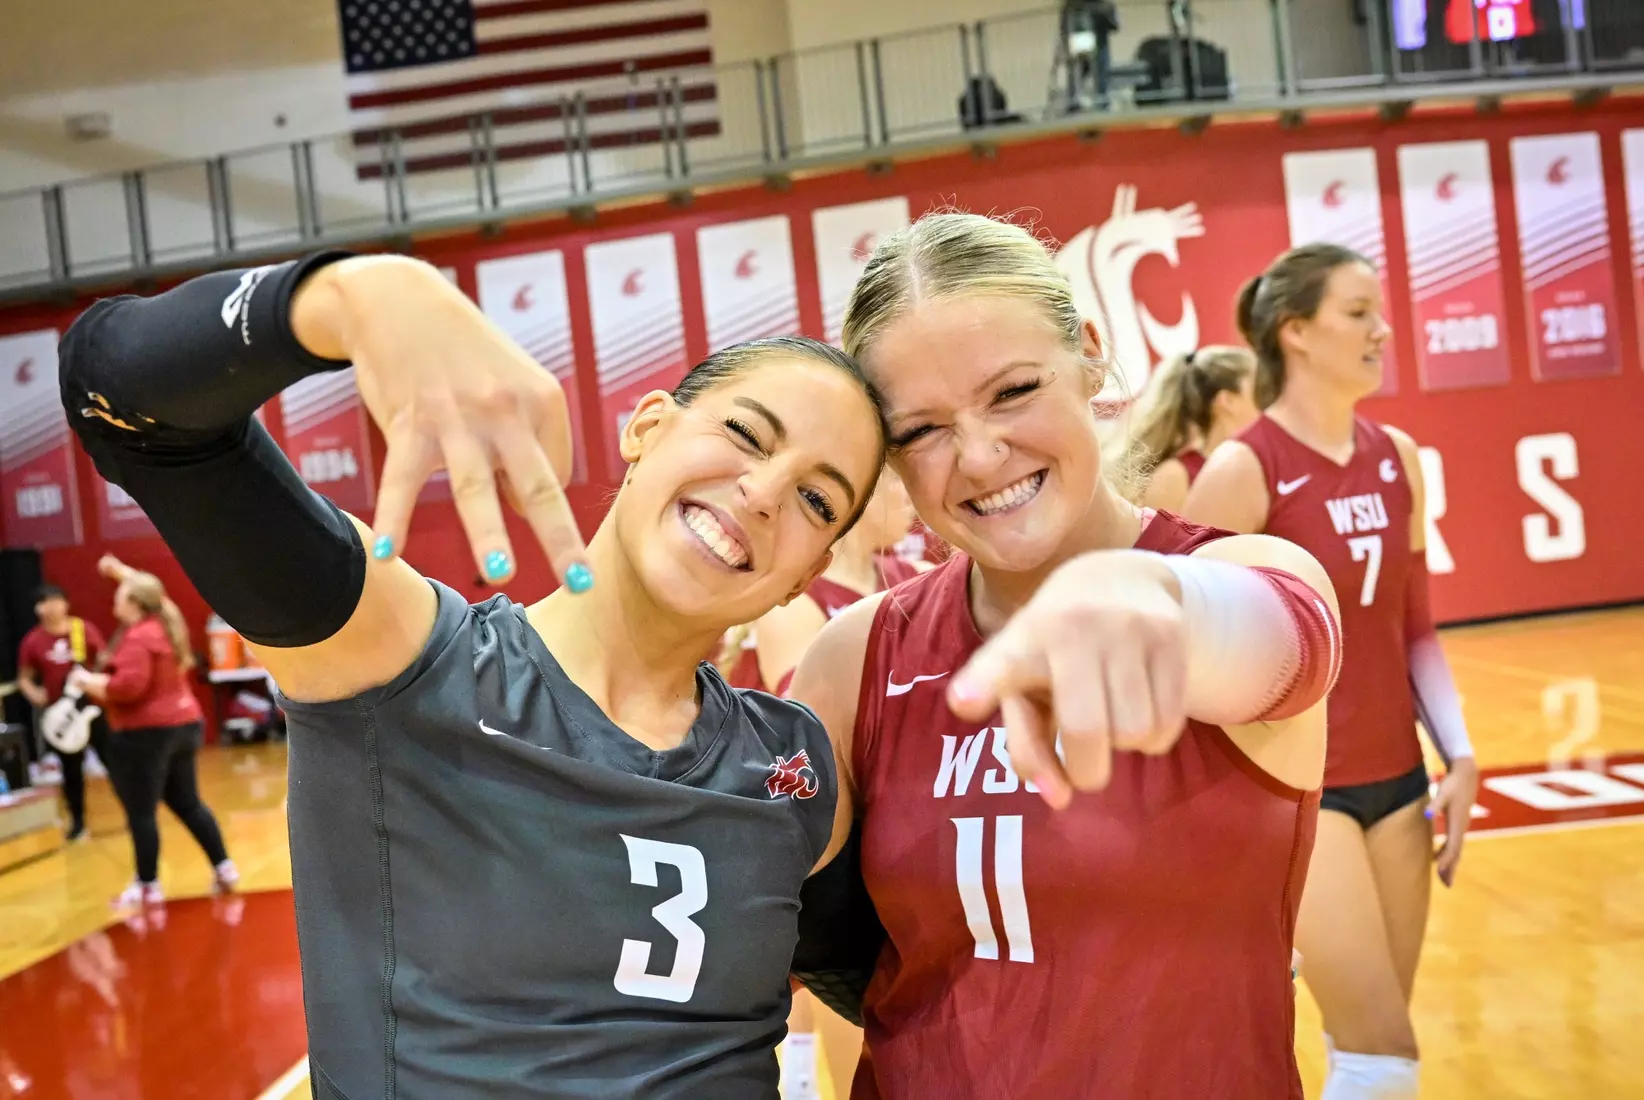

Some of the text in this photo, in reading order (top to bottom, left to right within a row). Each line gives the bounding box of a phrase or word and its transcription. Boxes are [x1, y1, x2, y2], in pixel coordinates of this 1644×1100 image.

[1324, 492, 1389, 535] WSU
[1346, 534, 1383, 607] 7
[933, 727, 1067, 798] WS
[613, 834, 708, 1003] 3
[950, 815, 1034, 963] 11
